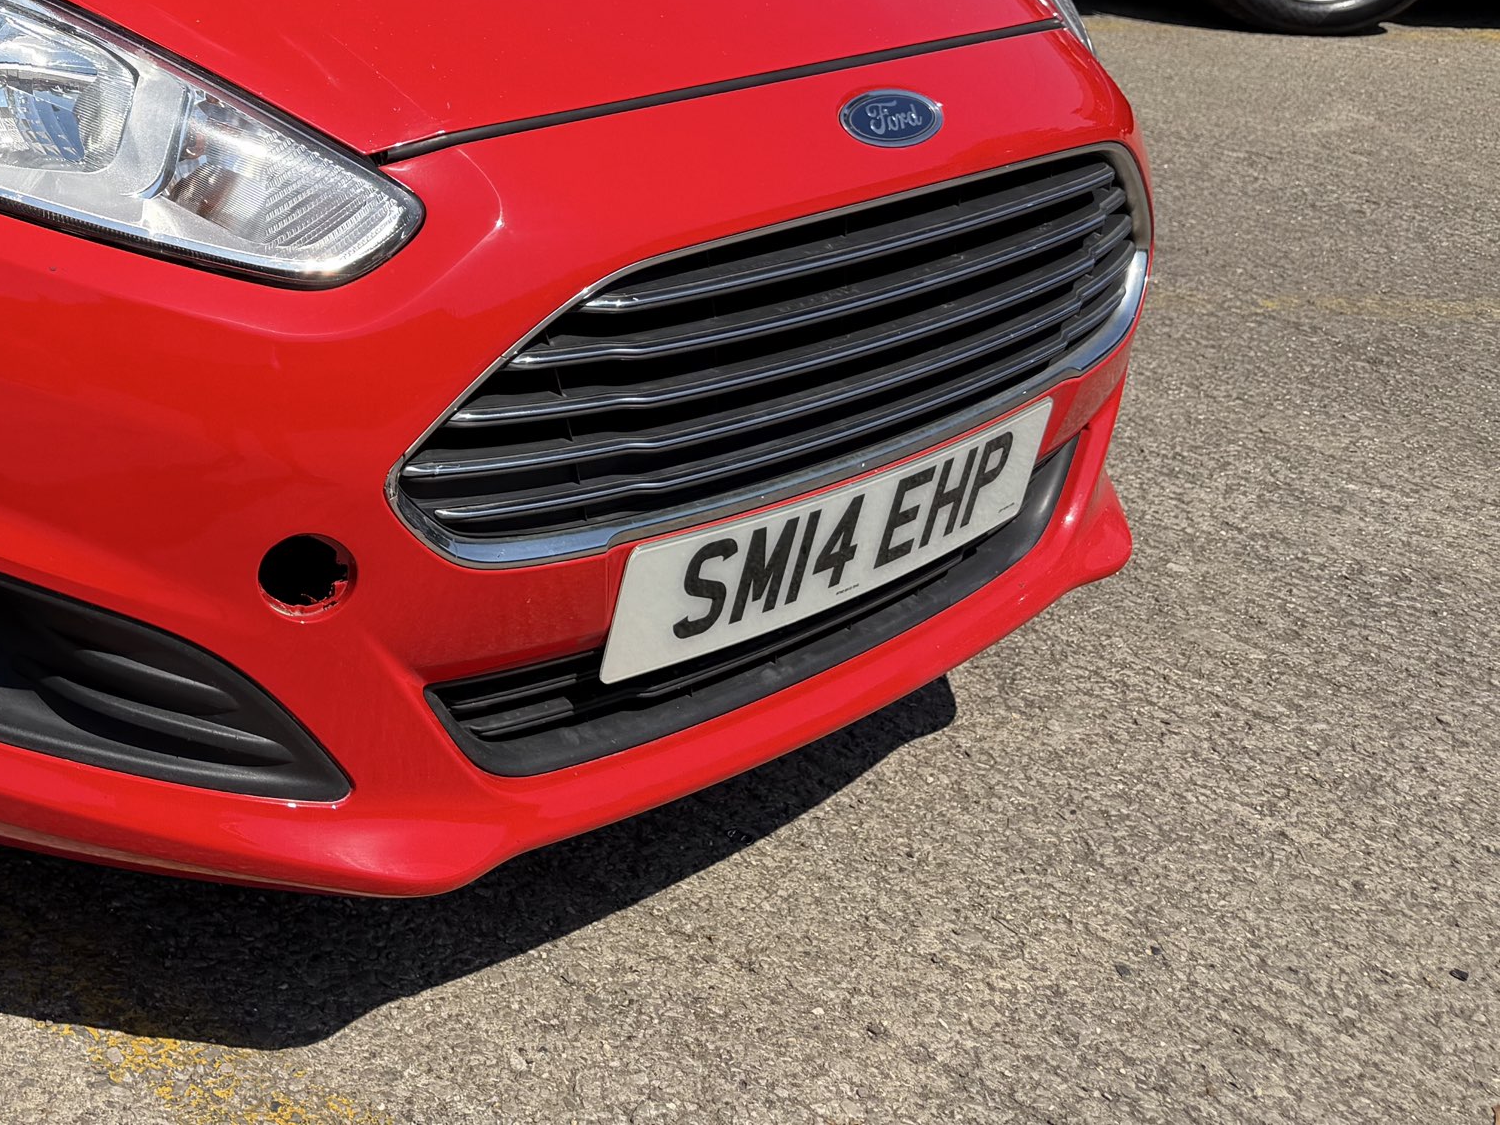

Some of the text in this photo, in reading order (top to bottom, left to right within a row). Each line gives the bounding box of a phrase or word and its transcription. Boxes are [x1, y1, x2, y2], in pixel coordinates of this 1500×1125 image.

[865, 100, 922, 135] Ford
[672, 431, 1013, 639] SM14 EHP
